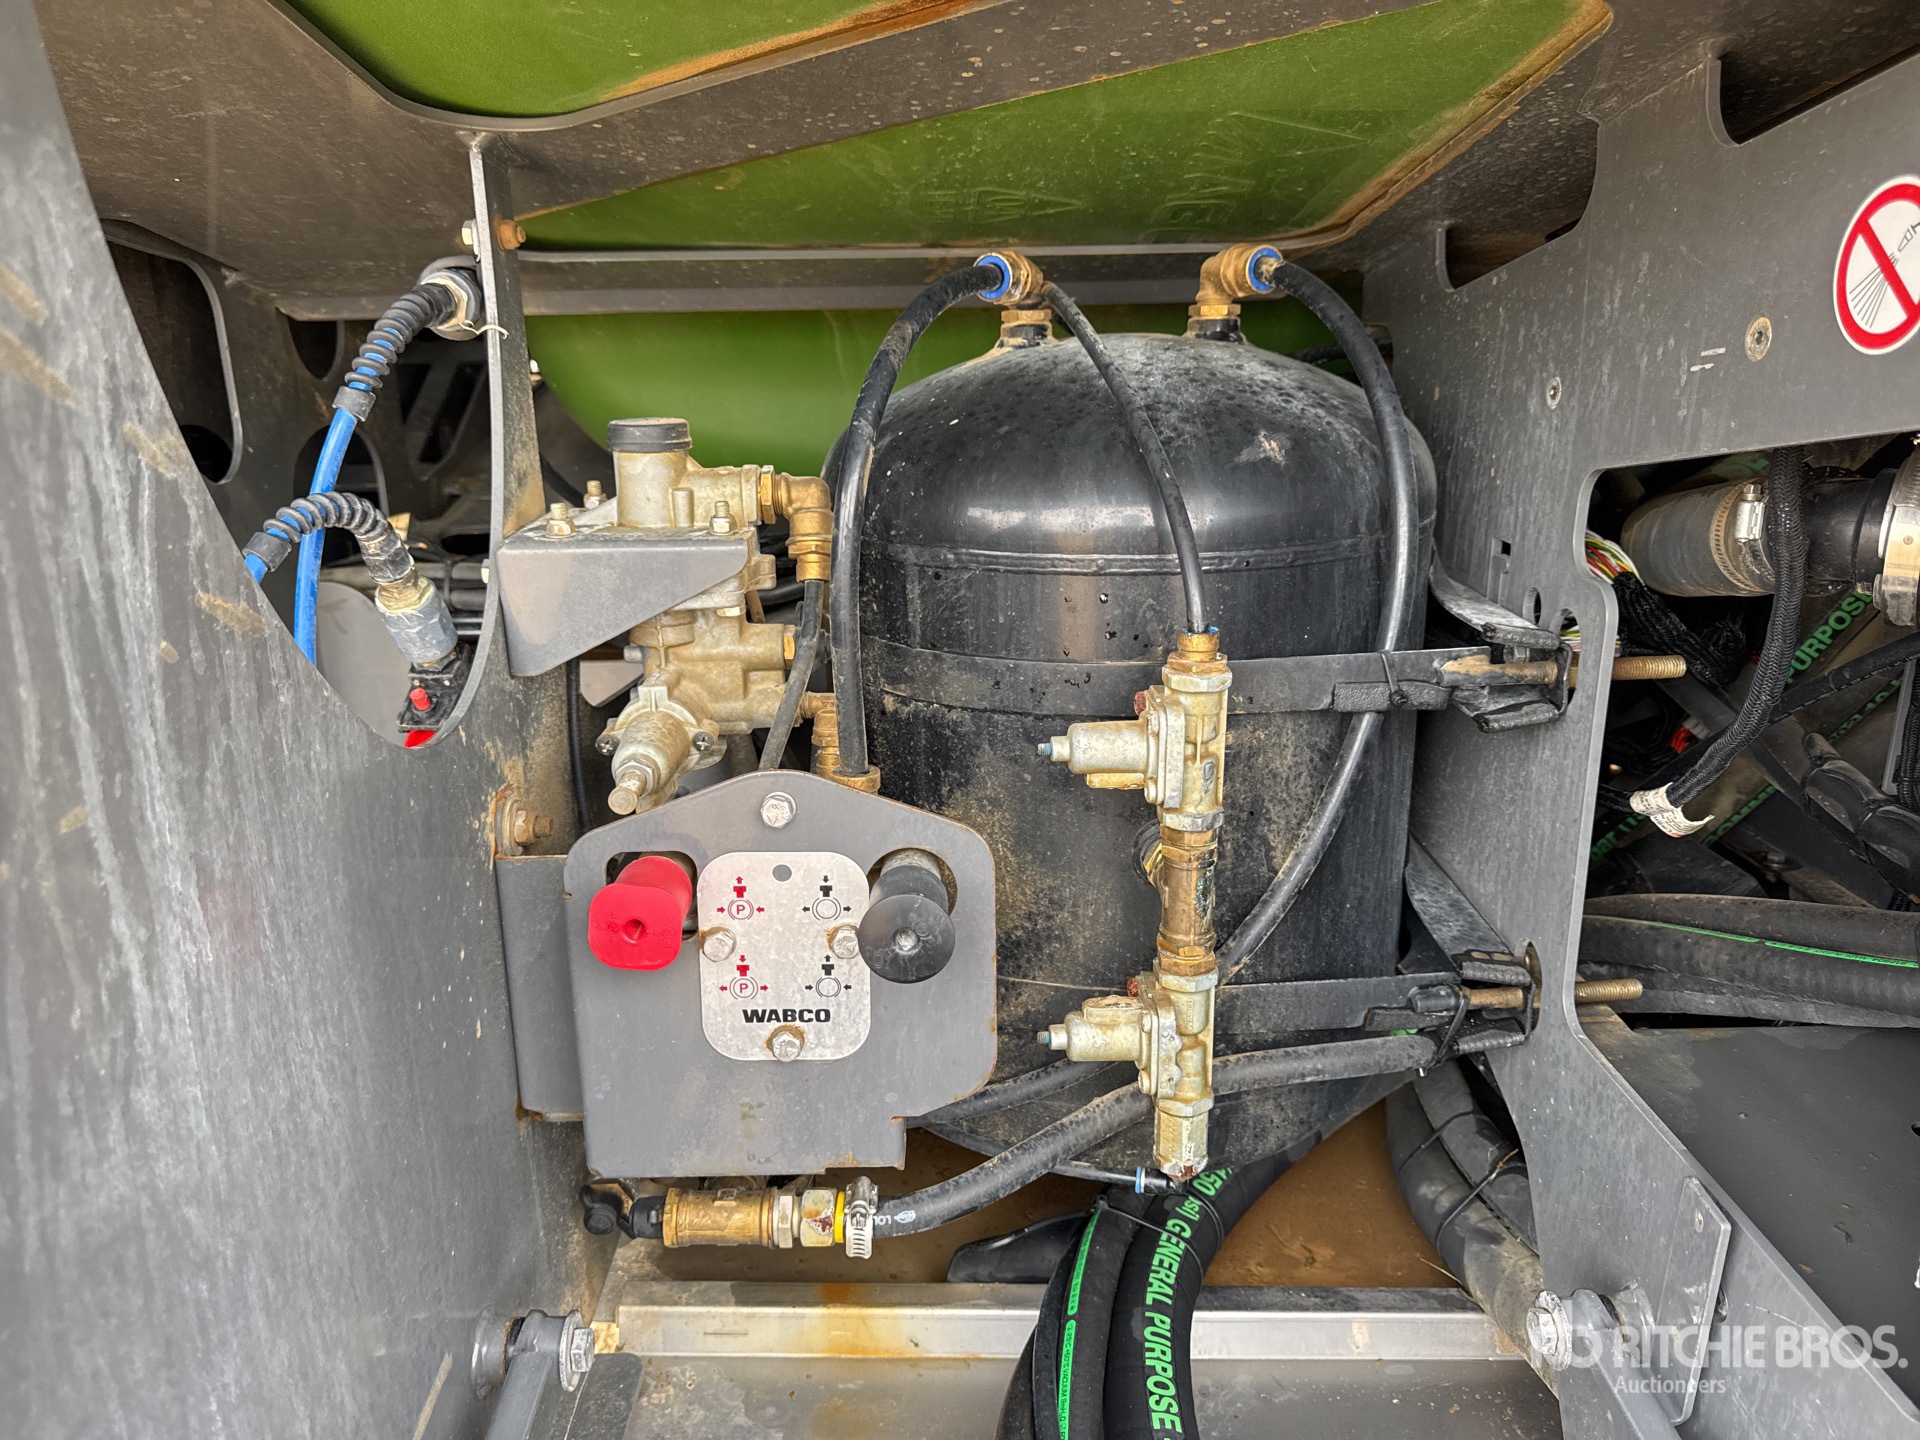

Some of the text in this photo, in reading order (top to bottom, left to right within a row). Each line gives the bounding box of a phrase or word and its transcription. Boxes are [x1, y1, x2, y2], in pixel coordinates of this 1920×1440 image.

[736, 904, 746, 916] P
[739, 983, 749, 994] P
[742, 1008, 831, 1024] WABCO
[1145, 1218, 1192, 1306] GENERAL
[1143, 1311, 1183, 1433] PURPOSE
